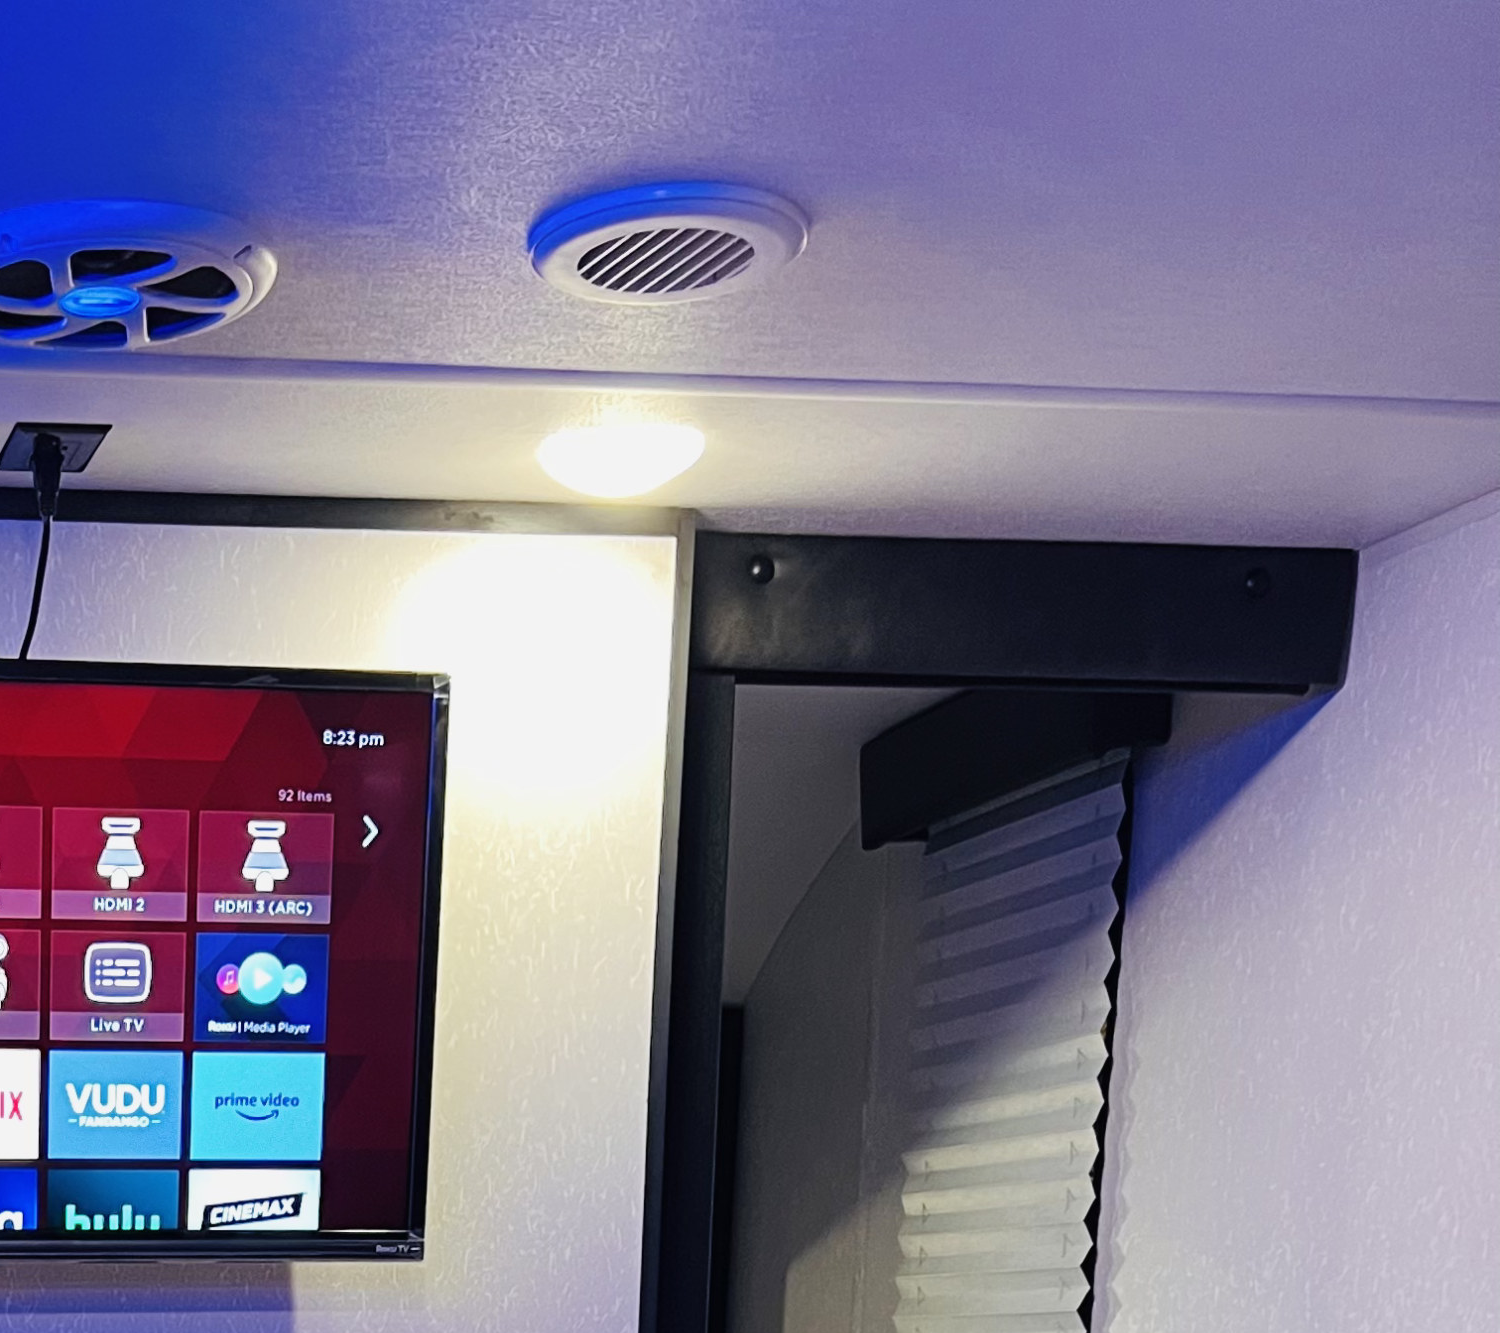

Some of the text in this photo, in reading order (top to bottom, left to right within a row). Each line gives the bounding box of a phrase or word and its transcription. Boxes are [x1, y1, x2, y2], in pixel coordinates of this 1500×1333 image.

[322, 729, 384, 749] 8:23 pm
[278, 789, 332, 803] 92 Items
[93, 897, 145, 913] HDMI 2
[214, 899, 313, 917] HDMI 3 (ARC)
[90, 1018, 145, 1032] Live TV
[243, 1021, 276, 1034] Media
[277, 1021, 311, 1036] Player
[65, 1083, 165, 1115] VUDU
[214, 1091, 299, 1109] prime video
[209, 1197, 296, 1225] CINEMAX
